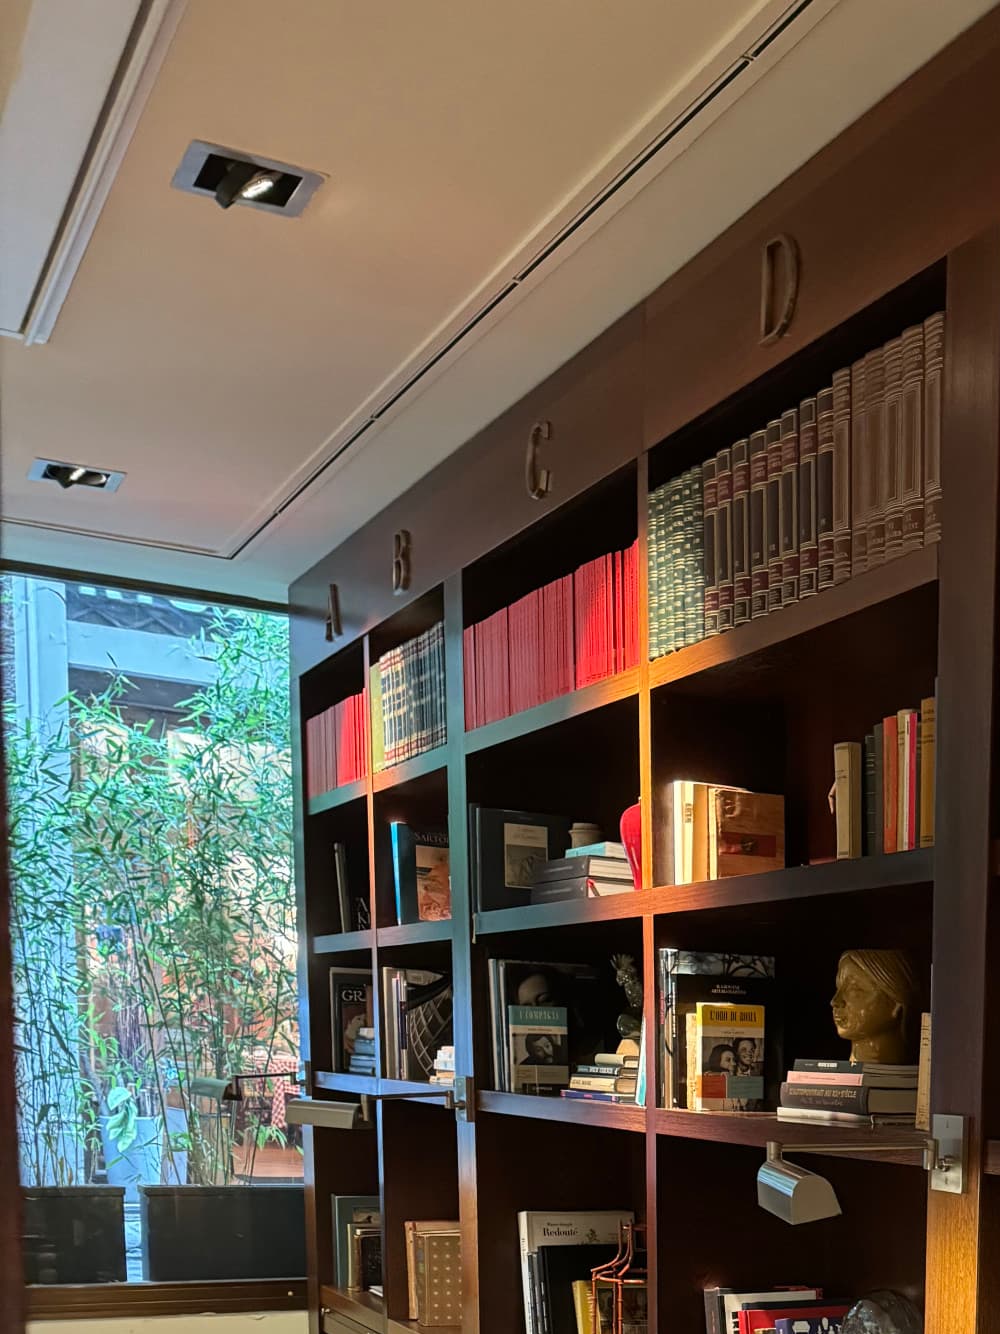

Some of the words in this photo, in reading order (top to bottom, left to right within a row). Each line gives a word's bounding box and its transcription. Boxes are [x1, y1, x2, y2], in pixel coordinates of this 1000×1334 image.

[759, 234, 801, 345] D
[527, 421, 552, 500] C
[393, 529, 411, 595] B
[326, 583, 344, 642] A
[542, 1226, 579, 1238] Redouté
